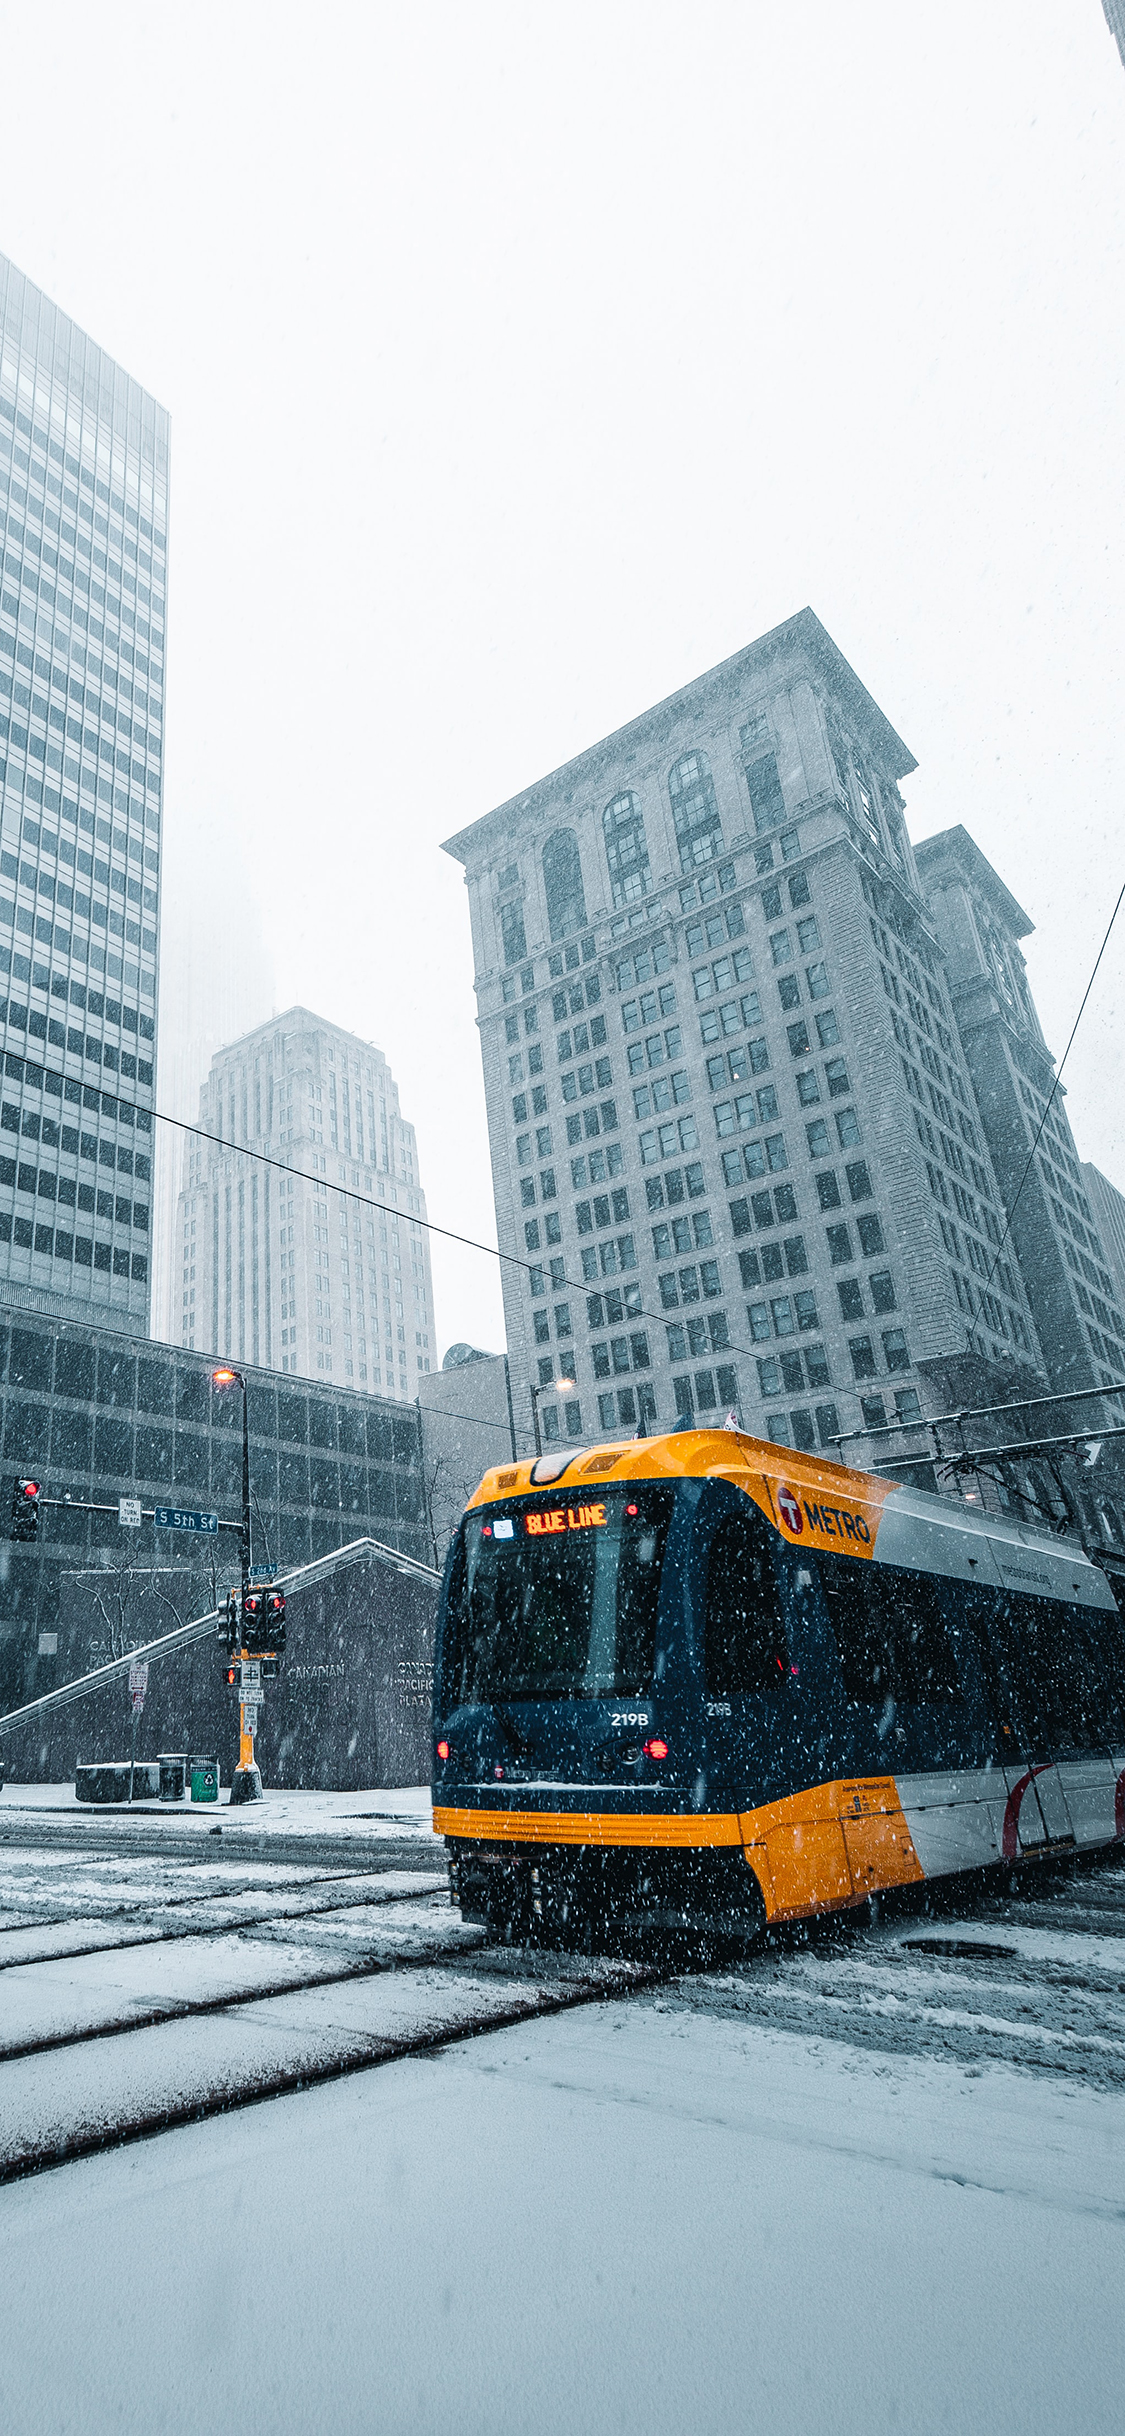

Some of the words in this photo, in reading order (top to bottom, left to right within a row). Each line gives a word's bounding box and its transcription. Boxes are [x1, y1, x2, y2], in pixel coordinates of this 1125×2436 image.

[160, 1511, 168, 1523] S
[173, 1513, 195, 1527] 5th
[200, 1517, 214, 1529] St
[526, 1511, 565, 1535] BLUE
[567, 1503, 607, 1529] LINE
[803, 1500, 871, 1544] METRO
[706, 1702, 732, 1716] 219B
[611, 1713, 649, 1726] 219B
